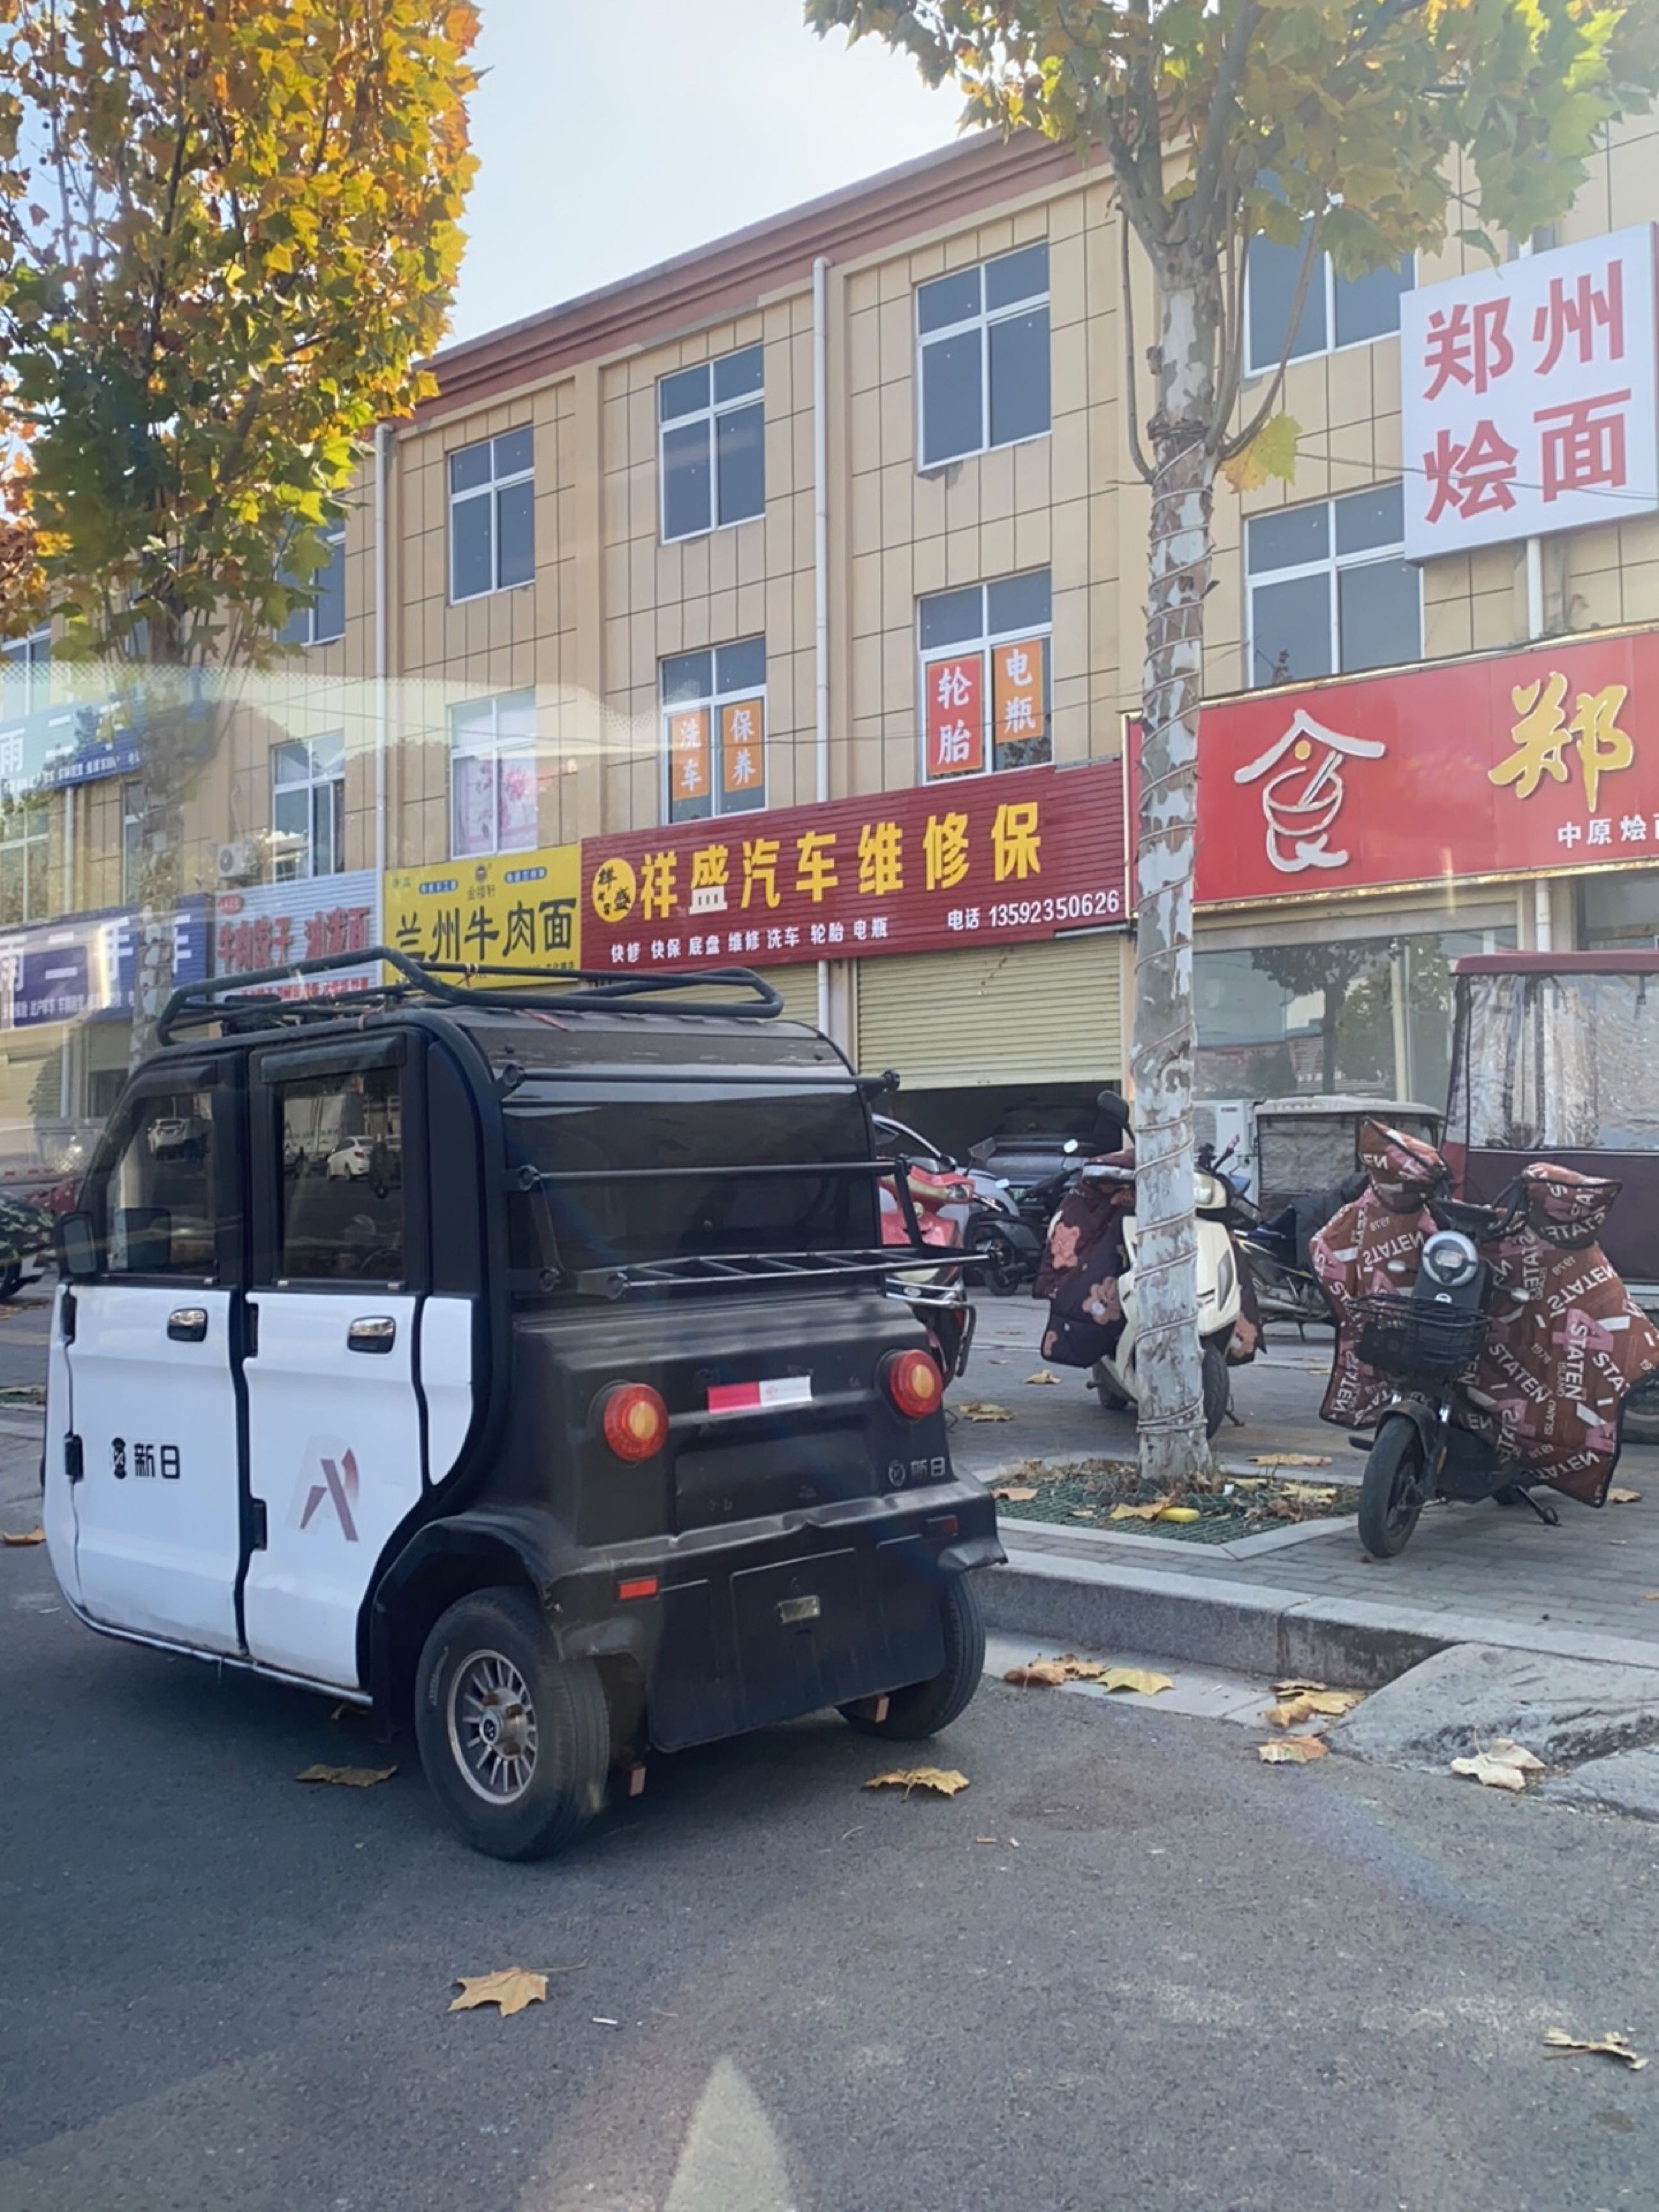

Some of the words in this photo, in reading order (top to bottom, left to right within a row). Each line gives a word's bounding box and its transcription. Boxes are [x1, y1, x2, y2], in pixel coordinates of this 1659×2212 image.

[1423, 259, 1624, 401] 郑州
[1423, 388, 1631, 524] 烩面
[937, 666, 973, 765] 轮胎
[1004, 648, 1036, 734] 电瓶
[680, 717, 702, 792] 洗车
[729, 709, 757, 786] 保养
[1487, 671, 1634, 813] 郑
[640, 801, 1041, 921] 祥盛汽车维修保
[1557, 813, 1659, 849] 中原烩
[396, 897, 577, 963] 兰州牛肉面
[610, 941, 641, 964] 快修
[650, 938, 682, 960] 快保
[688, 934, 720, 956] 底盘
[728, 929, 761, 952] 维修
[767, 926, 800, 950] 洗车
[810, 921, 844, 945] 轮胎
[853, 916, 889, 941] 电瓶
[947, 906, 981, 931] 电话
[988, 889, 1120, 927] 13592350626
[1488, 1343, 1550, 1403] STATEN
[1565, 1323, 1587, 1400] STATEN
[132, 1443, 180, 1479] 新日
